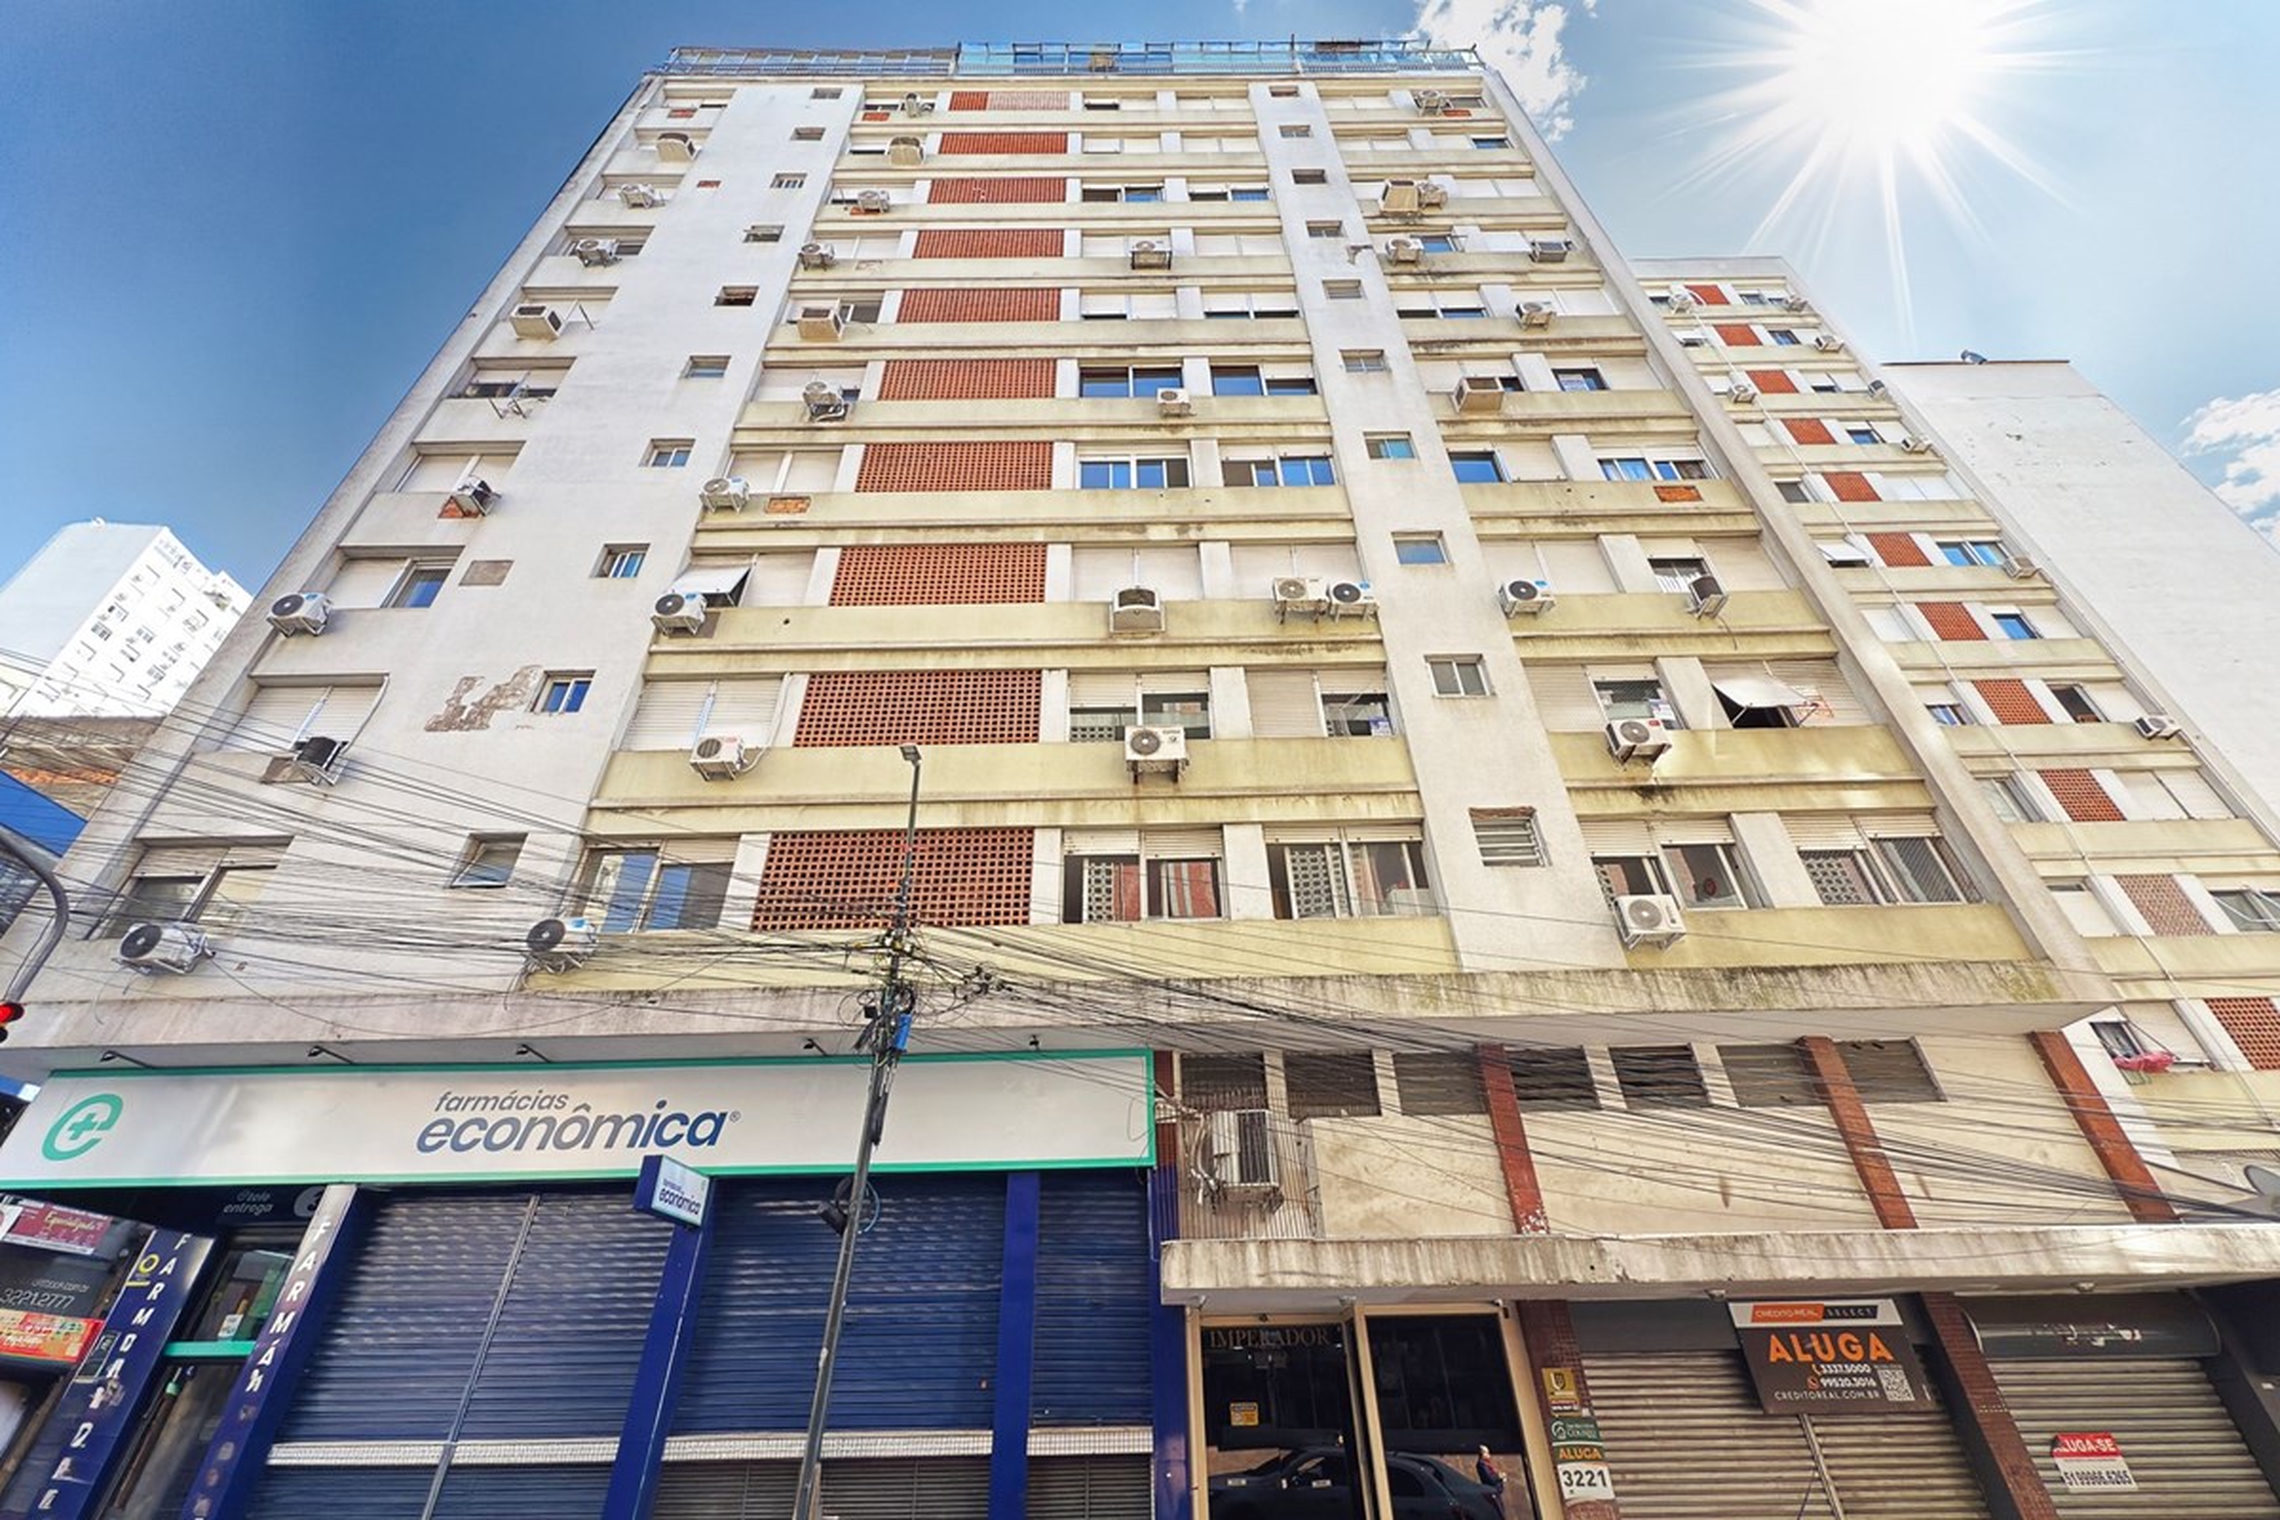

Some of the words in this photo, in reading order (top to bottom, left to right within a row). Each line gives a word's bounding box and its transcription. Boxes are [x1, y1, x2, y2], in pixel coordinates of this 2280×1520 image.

[434, 1089, 569, 1112] farmácias
[417, 1099, 728, 1153] econômica
[223, 1203, 274, 1216] entrega
[1210, 1326, 1330, 1348] IMPERADOR
[1769, 1332, 1895, 1363] ALUGA
[1559, 1447, 1603, 1460] ALUGA
[1562, 1469, 1607, 1488] 3221
